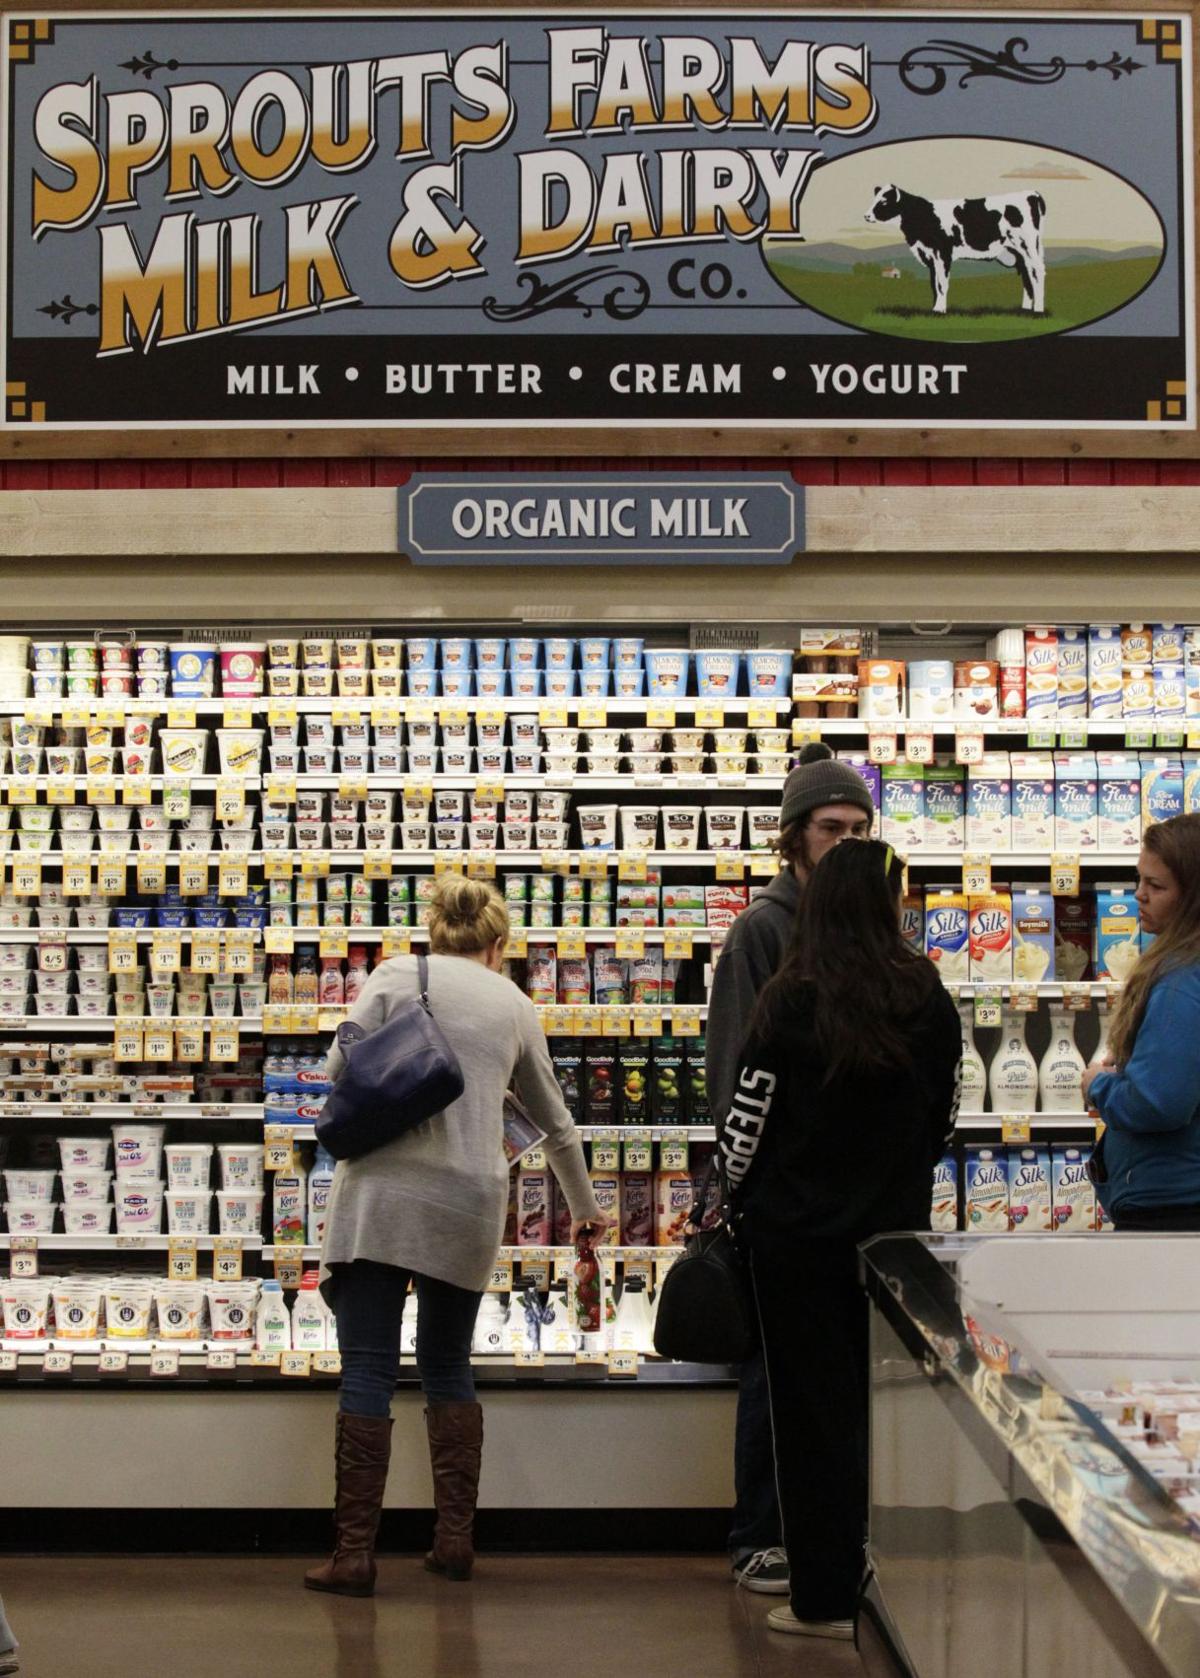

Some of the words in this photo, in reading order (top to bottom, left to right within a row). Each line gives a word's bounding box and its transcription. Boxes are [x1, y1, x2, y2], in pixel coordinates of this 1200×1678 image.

[32, 38, 519, 241] SPROUTS
[545, 24, 879, 139] FARMS
[96, 193, 361, 358] MILK
[388, 155, 488, 291] &
[515, 146, 825, 265] DAIRY
[667, 258, 748, 299] CO.
[226, 365, 321, 395] MILK
[385, 364, 543, 394] BUTTER
[608, 363, 743, 395] CREAM
[809, 363, 969, 396] YOGURT
[451, 498, 638, 539] ORGANIC
[650, 498, 751, 538] MILK
[1028, 649, 1055, 667] Silk
[1058, 650, 1085, 669] Silk
[1094, 648, 1120, 668] Silk
[1148, 798, 1180, 810] DREAM
[585, 814, 600, 822] SO
[641, 813, 656, 821] SO
[715, 814, 730, 822] SO
[758, 814, 774, 822] SO
[929, 911, 965, 936] Silk
[971, 911, 1008, 936] Silk
[972, 1167, 1003, 1187] Silk
[1015, 1166, 1046, 1187] Silk
